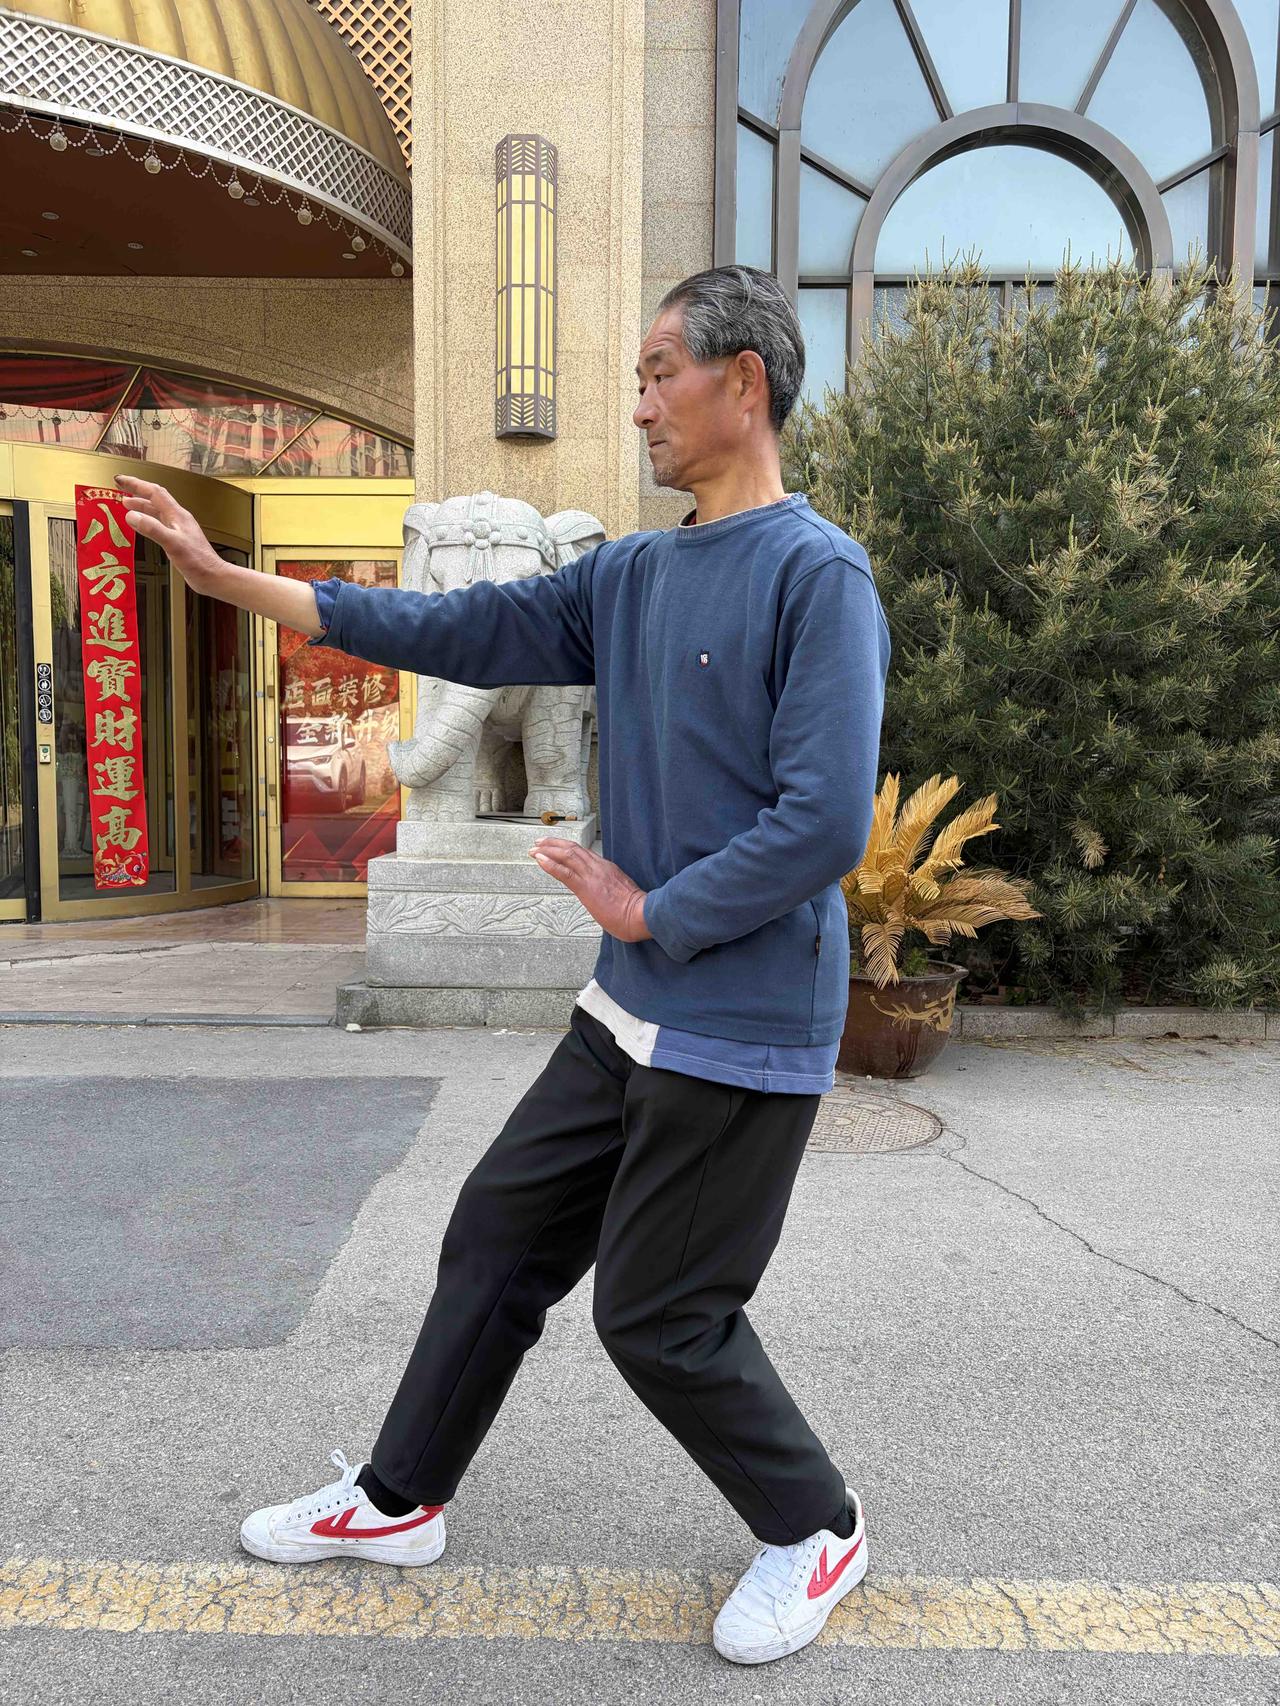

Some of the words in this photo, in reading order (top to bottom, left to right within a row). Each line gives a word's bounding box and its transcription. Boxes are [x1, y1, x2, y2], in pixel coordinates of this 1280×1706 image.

[284, 673, 388, 709] 店面装修
[296, 709, 399, 744] 全新升级
